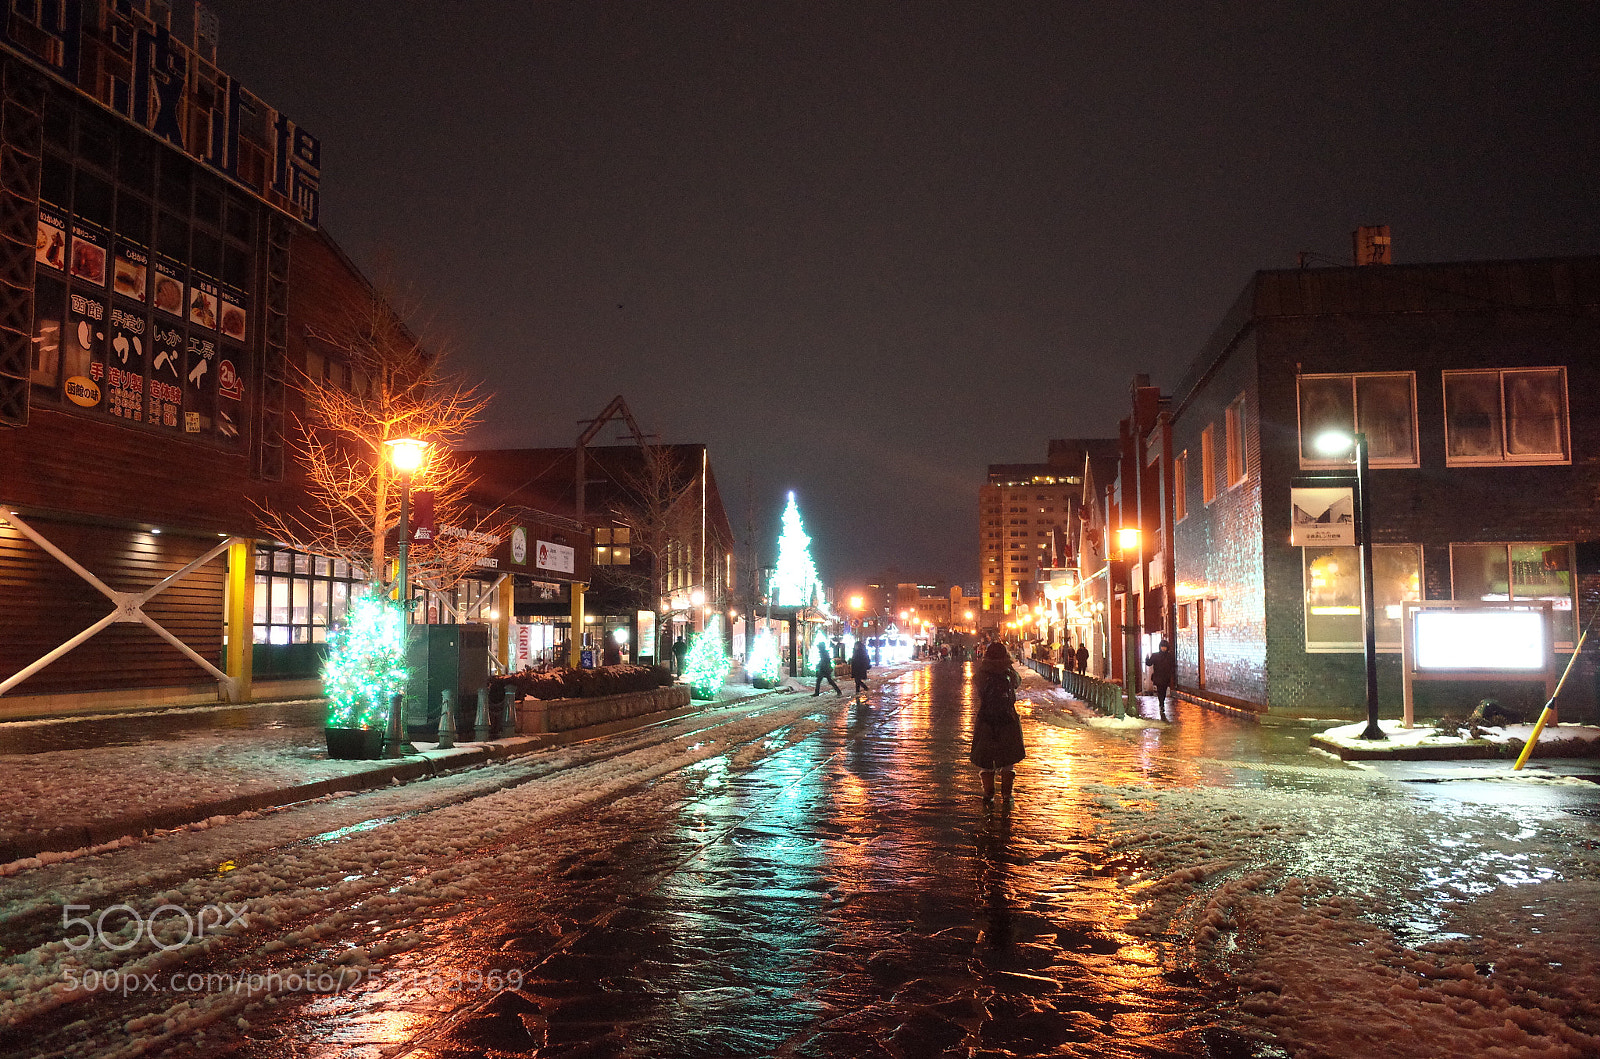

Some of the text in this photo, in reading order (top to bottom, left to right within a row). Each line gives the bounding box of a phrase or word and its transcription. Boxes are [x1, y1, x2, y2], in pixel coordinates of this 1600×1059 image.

[70, 294, 104, 321] 函館
[67, 381, 99, 402] 函館の味
[519, 626, 529, 660] KIRIN
